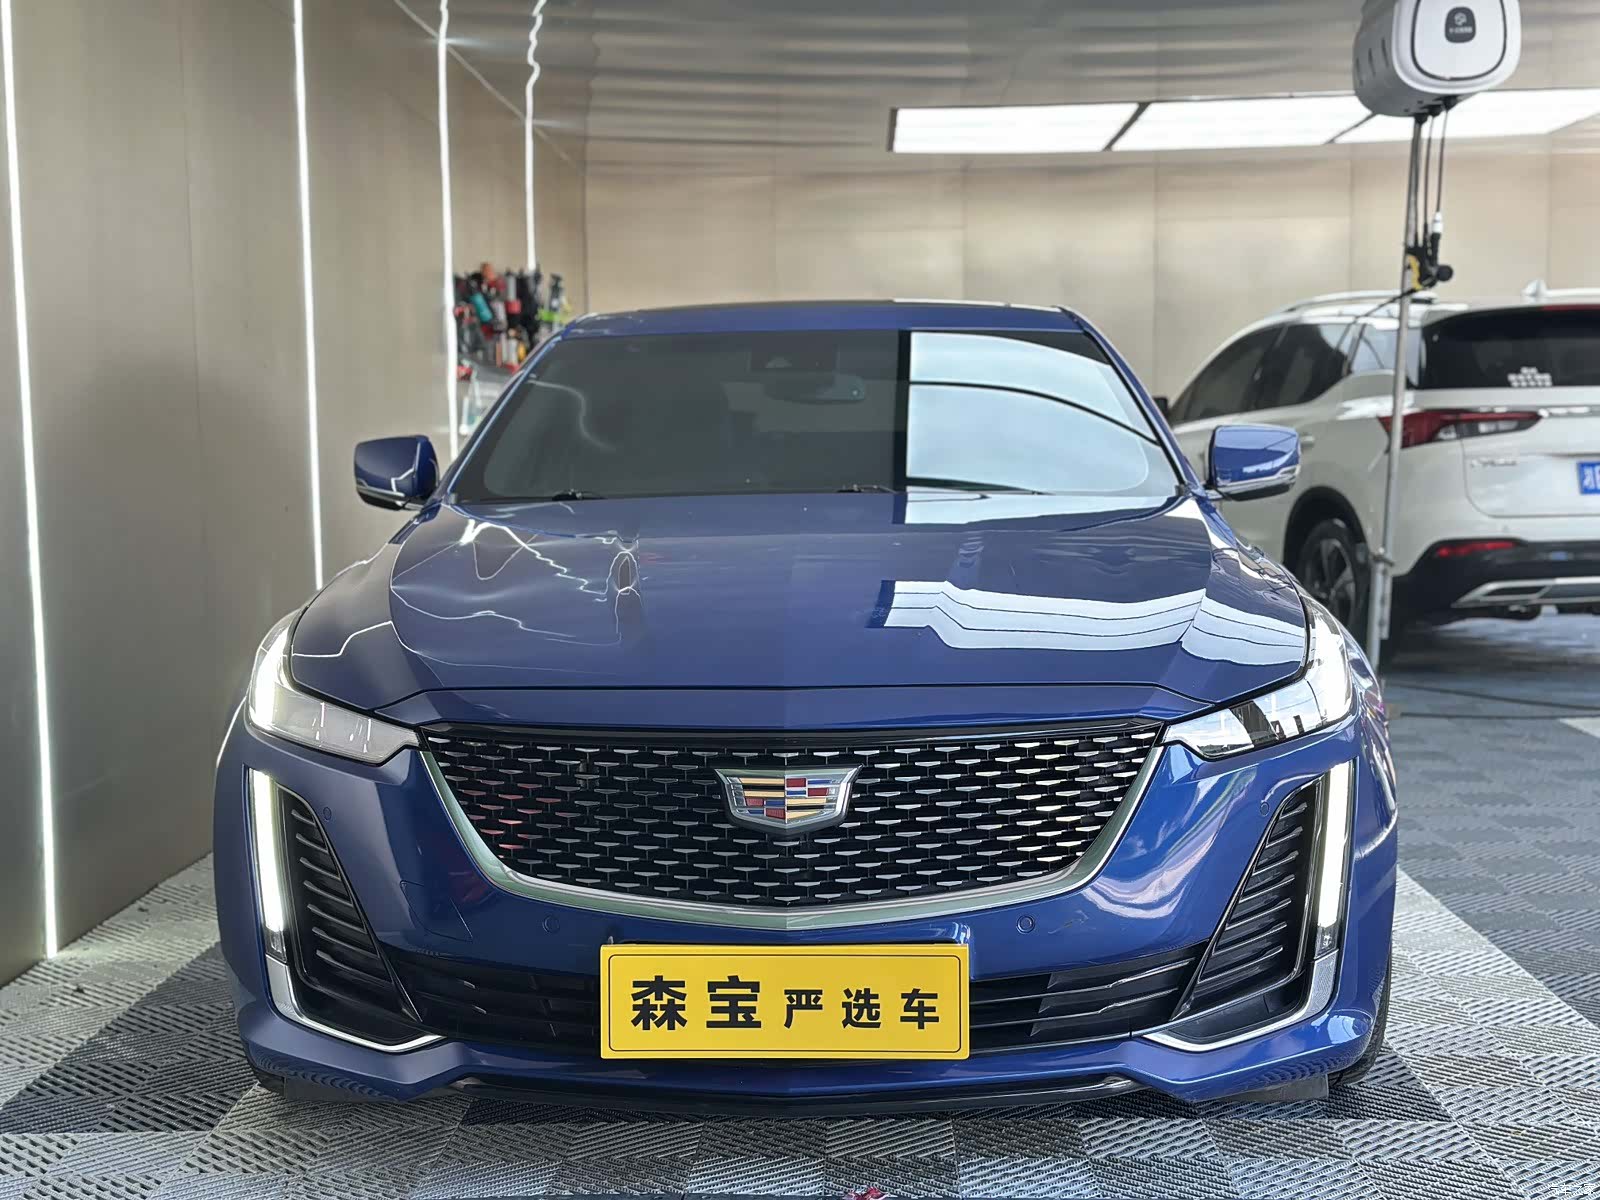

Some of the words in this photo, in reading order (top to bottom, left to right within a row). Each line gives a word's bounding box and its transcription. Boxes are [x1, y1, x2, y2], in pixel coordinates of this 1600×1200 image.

[631, 975, 940, 1030] 森宝严选车
